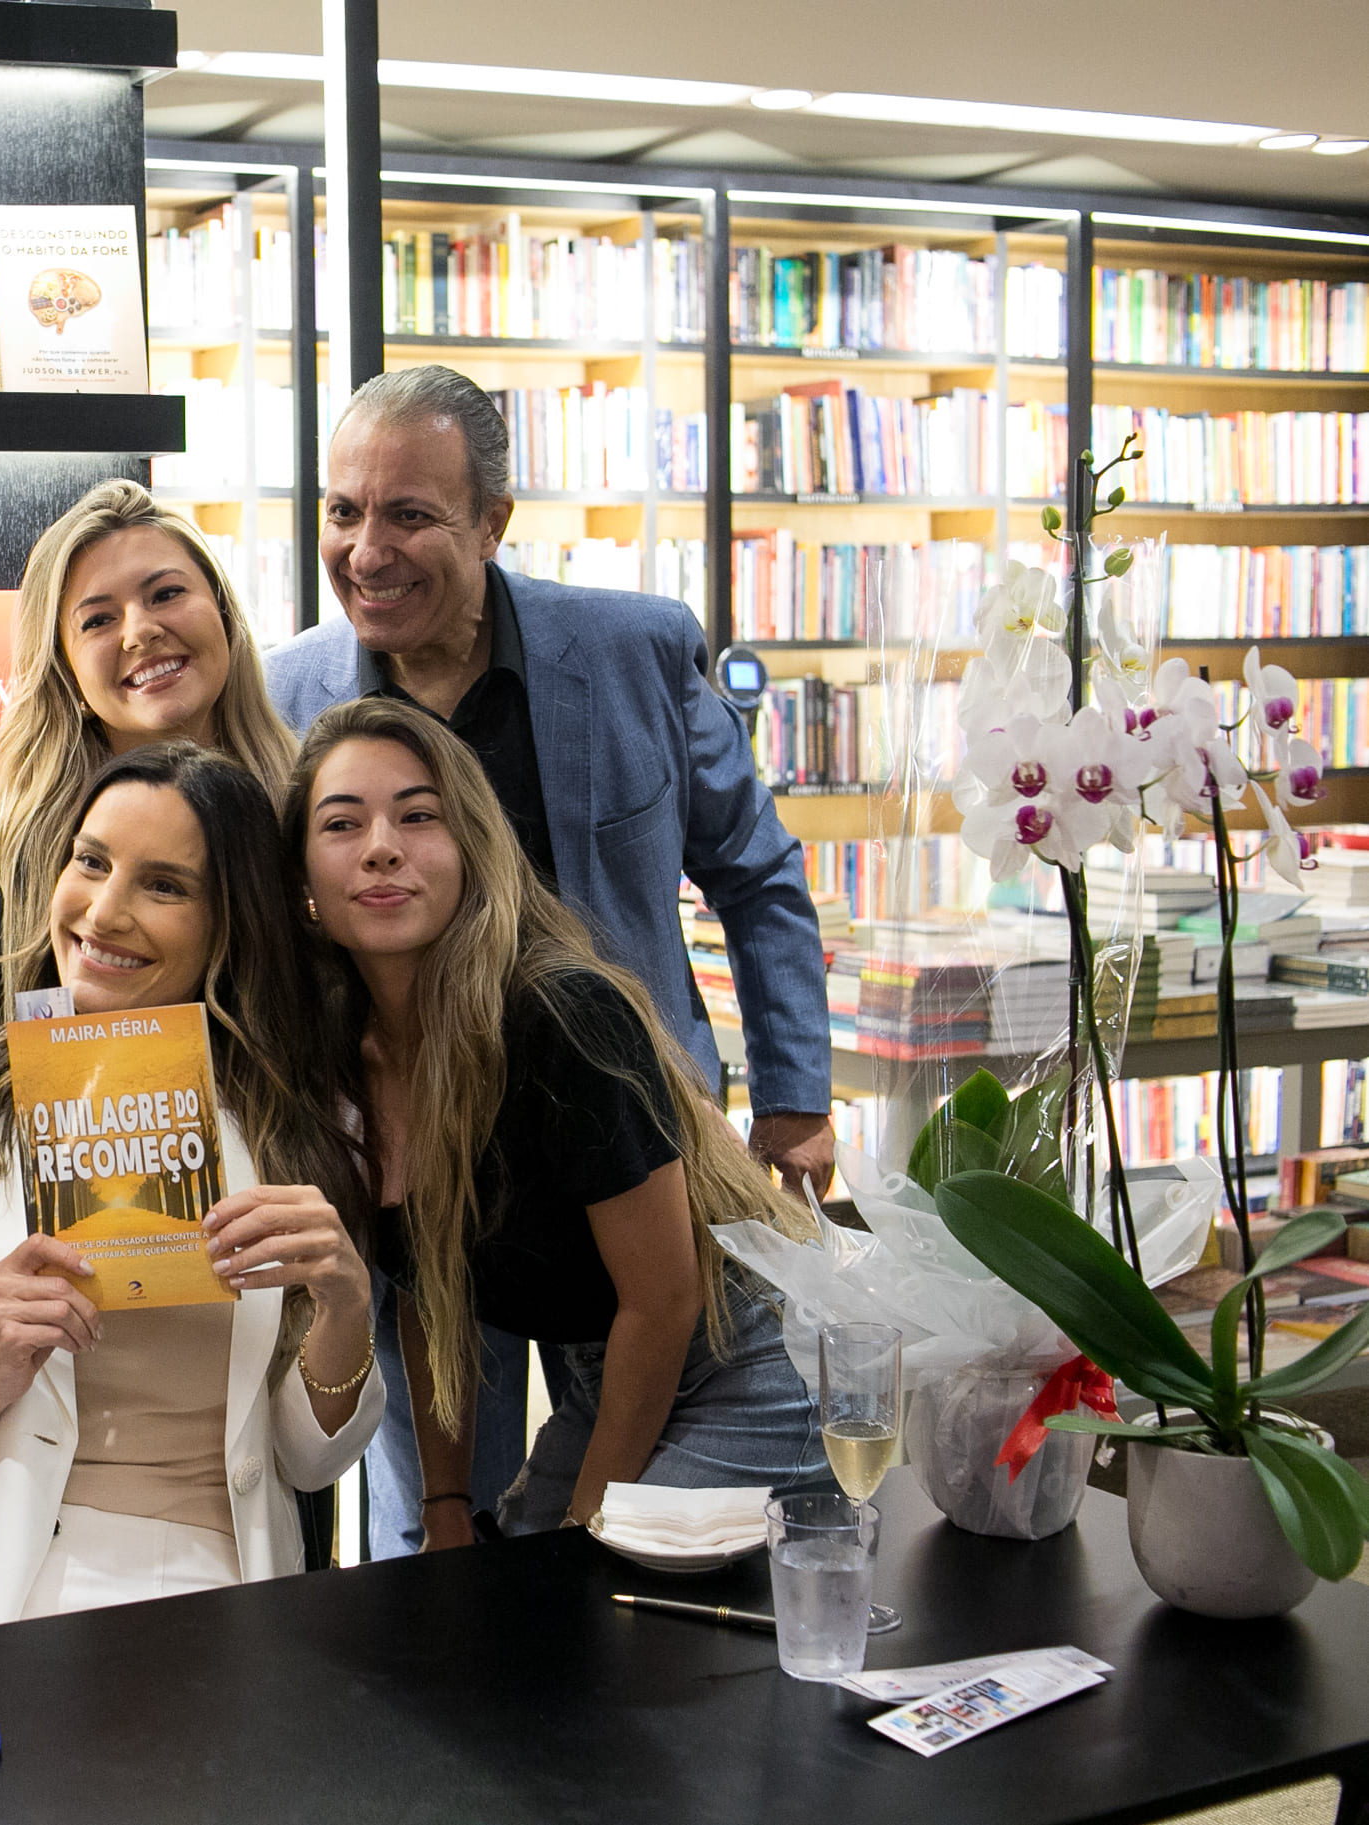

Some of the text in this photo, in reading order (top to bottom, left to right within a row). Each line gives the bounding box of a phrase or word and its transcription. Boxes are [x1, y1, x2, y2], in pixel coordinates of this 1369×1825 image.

[0, 229, 128, 240] DESCONSTRUINDO
[70, 246, 88, 256] DA
[92, 245, 128, 256] FOME
[22, 367, 63, 375] JUDSON
[50, 1016, 162, 1044] MAIRA FÉRIA
[33, 1088, 200, 1138] O MILAGRE DO
[35, 1132, 205, 1183] RECOMEÇO
[96, 1239, 108, 1249] DO
[109, 1236, 147, 1248] PASSADO
[156, 1231, 201, 1243] ENCONTRE
[127, 1248, 142, 1257] SER
[144, 1246, 169, 1257] QUEM
